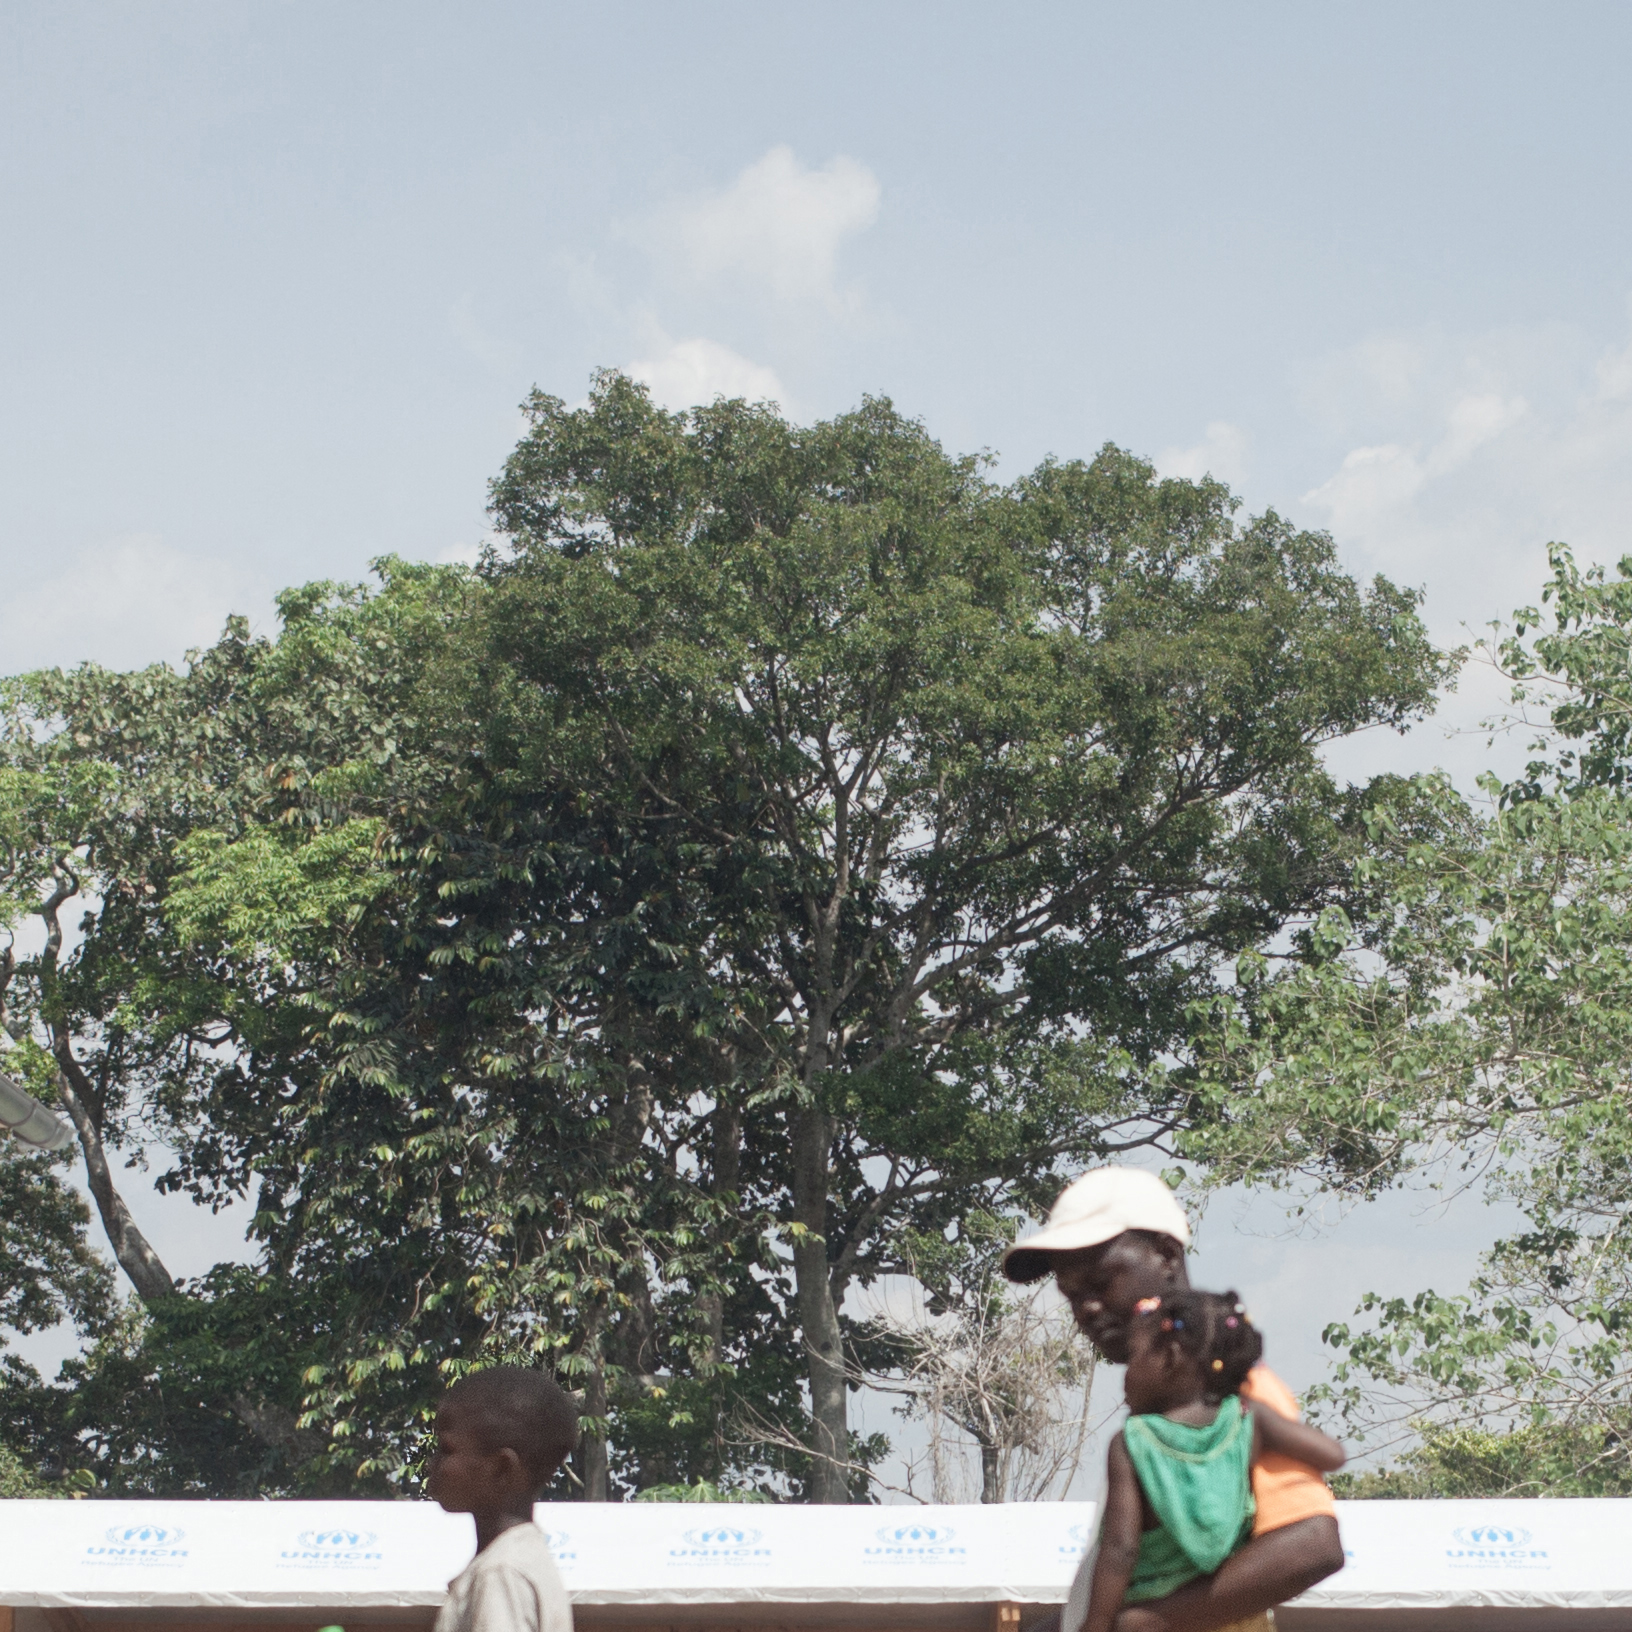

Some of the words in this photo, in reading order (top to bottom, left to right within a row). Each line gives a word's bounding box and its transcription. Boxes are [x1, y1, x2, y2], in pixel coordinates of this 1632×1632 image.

[87, 1547, 189, 1557] UNHCR
[281, 1551, 383, 1560] UNHCR
[1446, 1550, 1548, 1558] UNHCR
